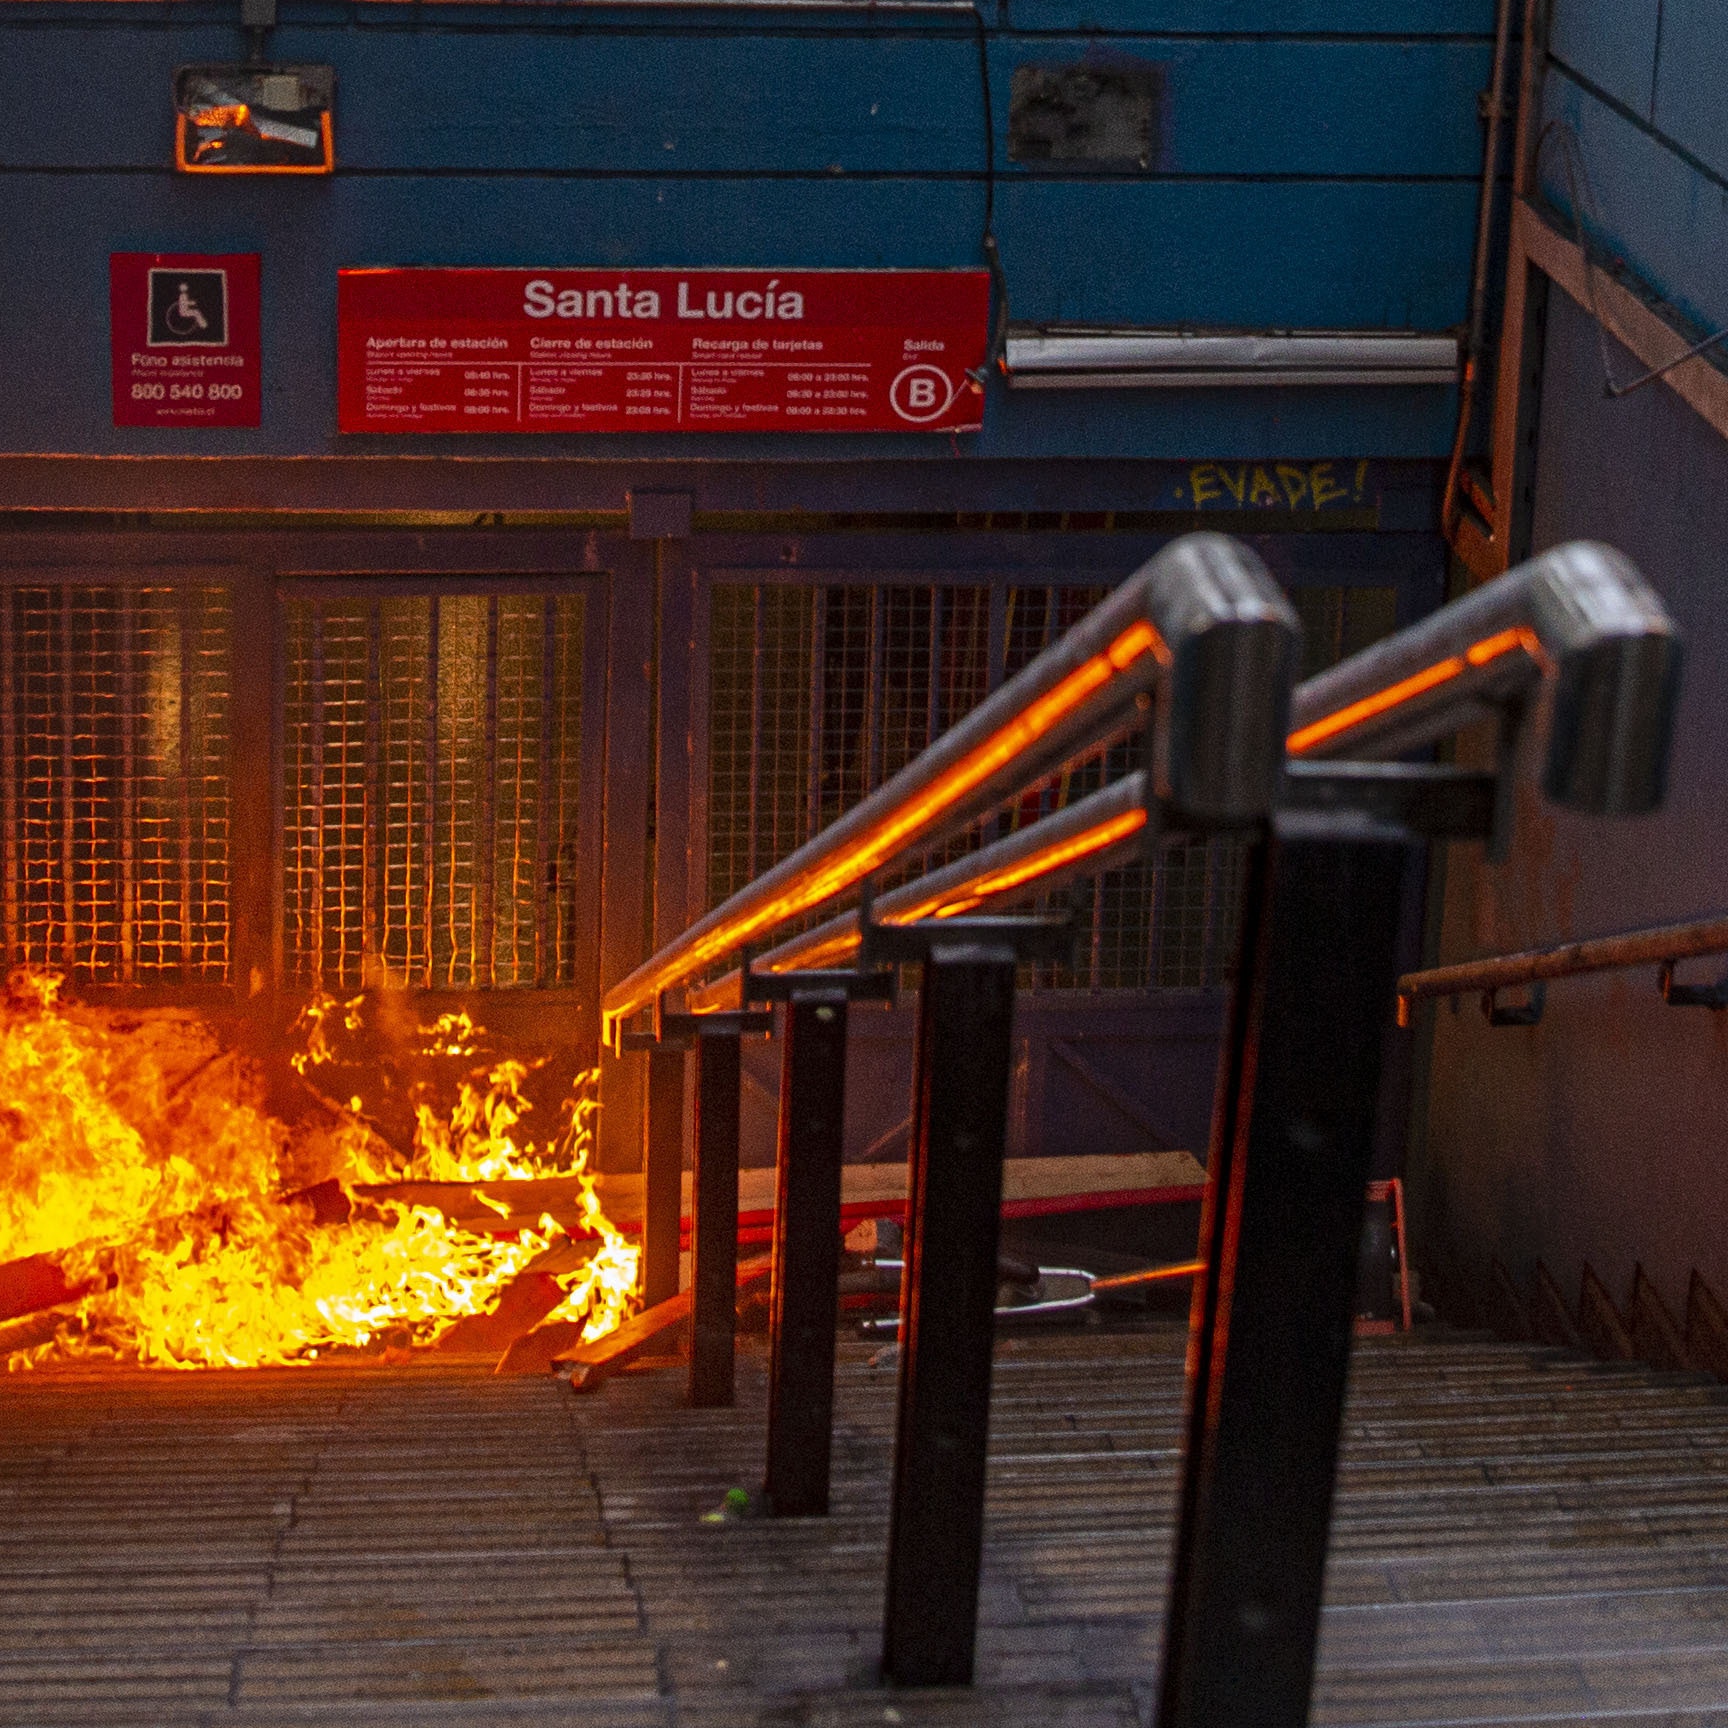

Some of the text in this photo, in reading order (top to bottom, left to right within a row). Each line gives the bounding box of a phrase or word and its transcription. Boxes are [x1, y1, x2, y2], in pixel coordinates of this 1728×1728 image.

[523, 279, 804, 319] Santa Lucía
[366, 337, 508, 350] Apertura de estación
[530, 336, 654, 349] Cierre de estación
[692, 338, 824, 352] Recarga de tarjetas
[903, 338, 945, 351] Salida
[131, 352, 244, 367] Fono asistencia
[131, 383, 243, 400] 800 540 800
[909, 378, 936, 407] B
